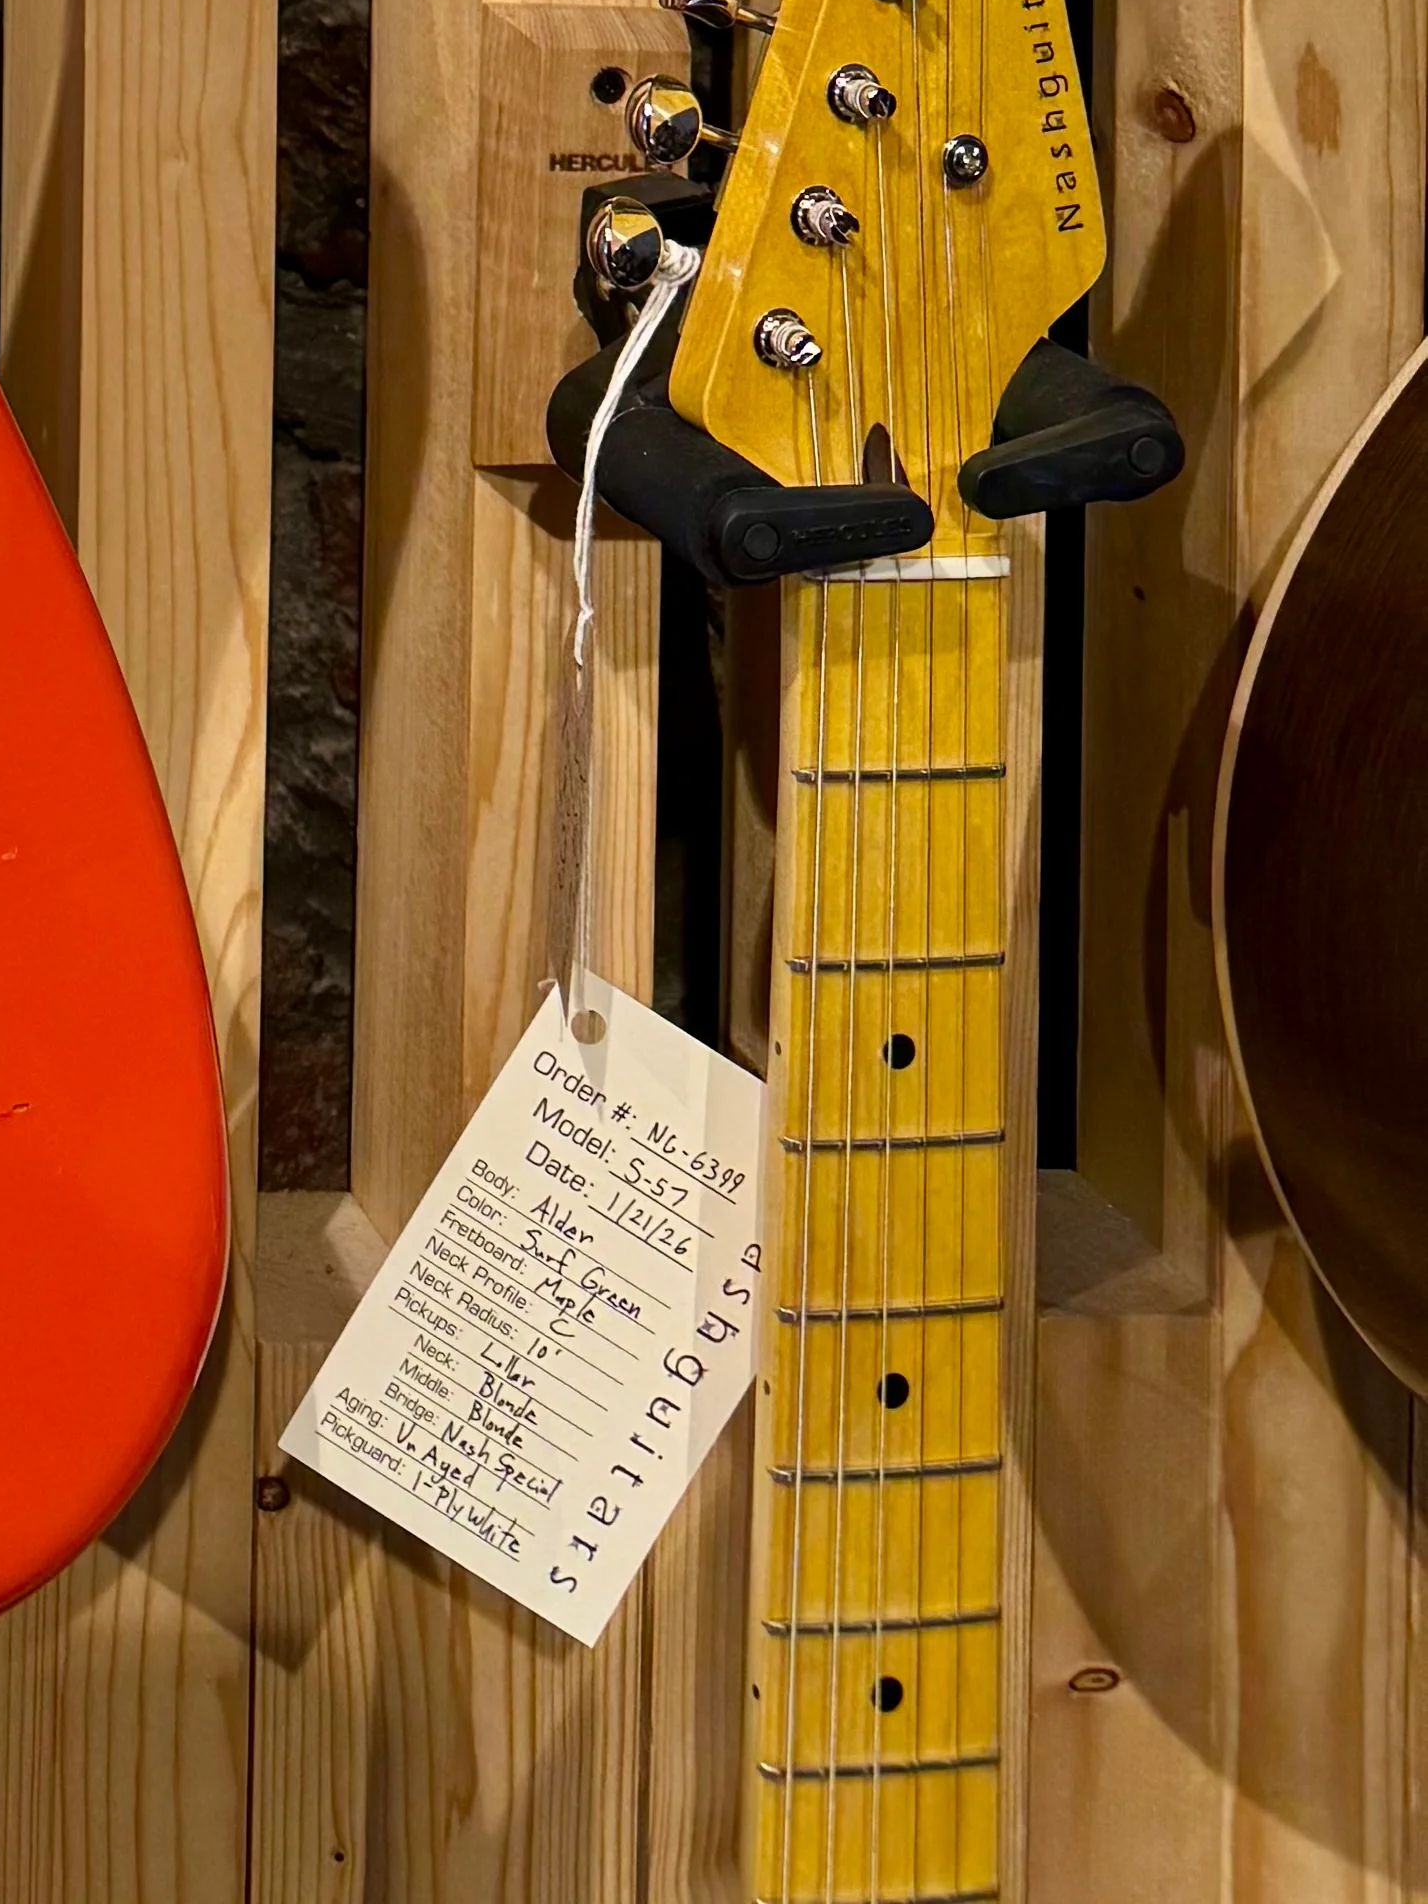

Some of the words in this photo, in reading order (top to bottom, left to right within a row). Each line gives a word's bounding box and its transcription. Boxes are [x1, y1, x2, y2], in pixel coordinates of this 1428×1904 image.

[548, 152, 672, 173] HERCUL
[532, 1050, 607, 1106] Order
[610, 1101, 637, 1131] #:
[525, 1140, 595, 1198] Date:
[606, 1191, 692, 1255] 1/21/26
[532, 1097, 616, 1164] Model:
[623, 1157, 689, 1207] S-57
[471, 1158, 520, 1200] Body:
[530, 1195, 594, 1244] Alder
[425, 1235, 469, 1273] Neck
[472, 1265, 534, 1314] Profile:
[549, 1317, 576, 1339] C
[440, 1209, 528, 1275] Fretboard:
[534, 1276, 595, 1325] Maple
[456, 1184, 508, 1226] Color:
[520, 1228, 576, 1276] Surf
[580, 1266, 642, 1320] Green
[394, 1286, 464, 1340] Pickups:
[409, 1260, 455, 1299] Neck
[456, 1291, 519, 1340] Radius:
[335, 1386, 389, 1428] Aging:
[399, 1357, 455, 1402] Middle:
[468, 1399, 524, 1449] Blonde
[413, 1333, 460, 1372] Neck:
[478, 1370, 539, 1426] Blonde
[550, 1243, 762, 1593] ashguitars
[320, 1410, 407, 1476] Pickguard:
[384, 1381, 440, 1426] Bridge:
[441, 1419, 491, 1465] Nash
[494, 1452, 564, 1503] Special
